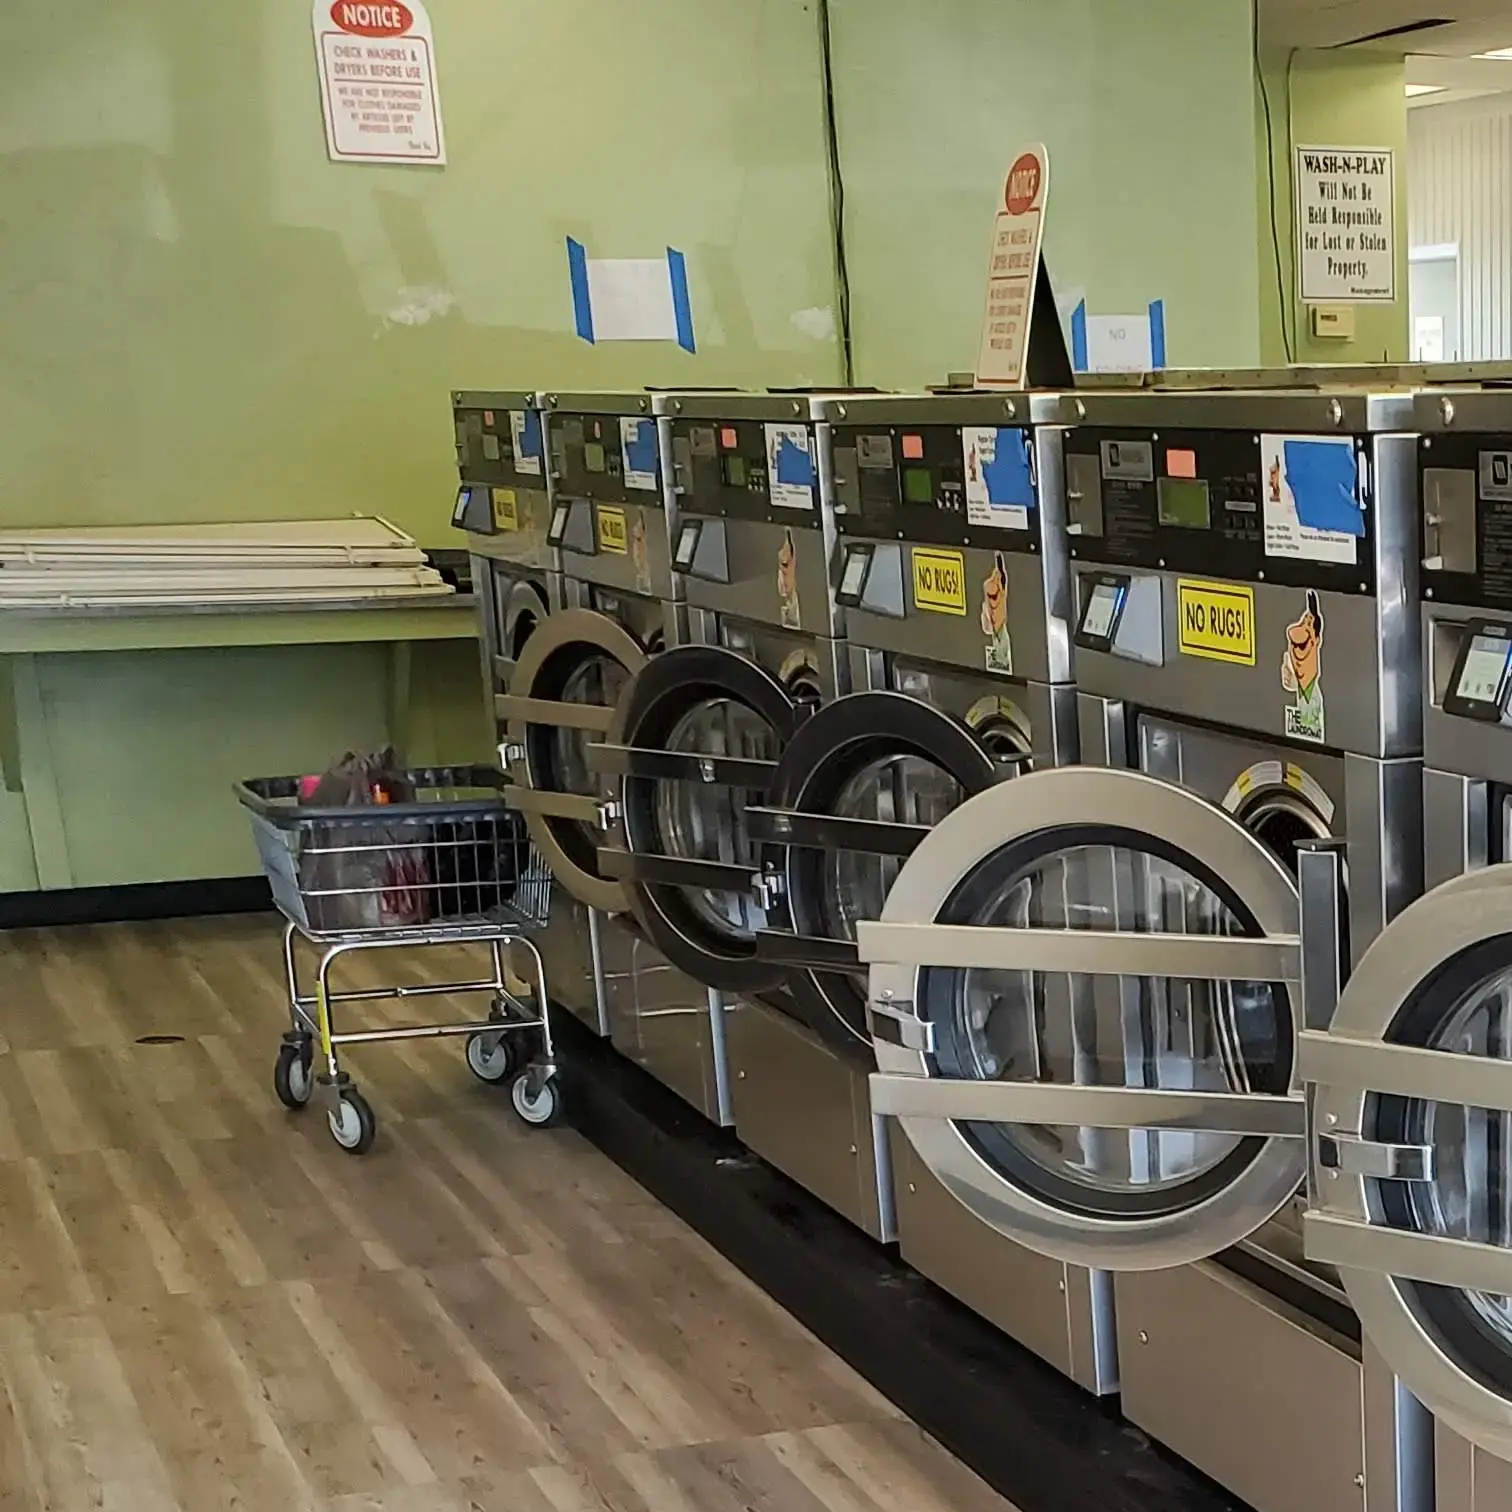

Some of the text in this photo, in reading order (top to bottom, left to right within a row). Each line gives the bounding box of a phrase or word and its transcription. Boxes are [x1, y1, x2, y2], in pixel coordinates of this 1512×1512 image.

[342, 3, 402, 28] NOTICE
[333, 45, 417, 61] CHECK WASHERS &
[333, 62, 421, 79] DRYERS BEFORE USE
[1304, 155, 1387, 175] WASH-N-PLAY
[1318, 181, 1372, 201] Will Not Be
[1308, 206, 1382, 229] Held Responsible
[1305, 231, 1387, 251] for Lost or Stolen
[1350, 287, 1389, 295] Management
[918, 567, 959, 596] NO RUGS!
[1185, 603, 1246, 640] NO RUGS!
